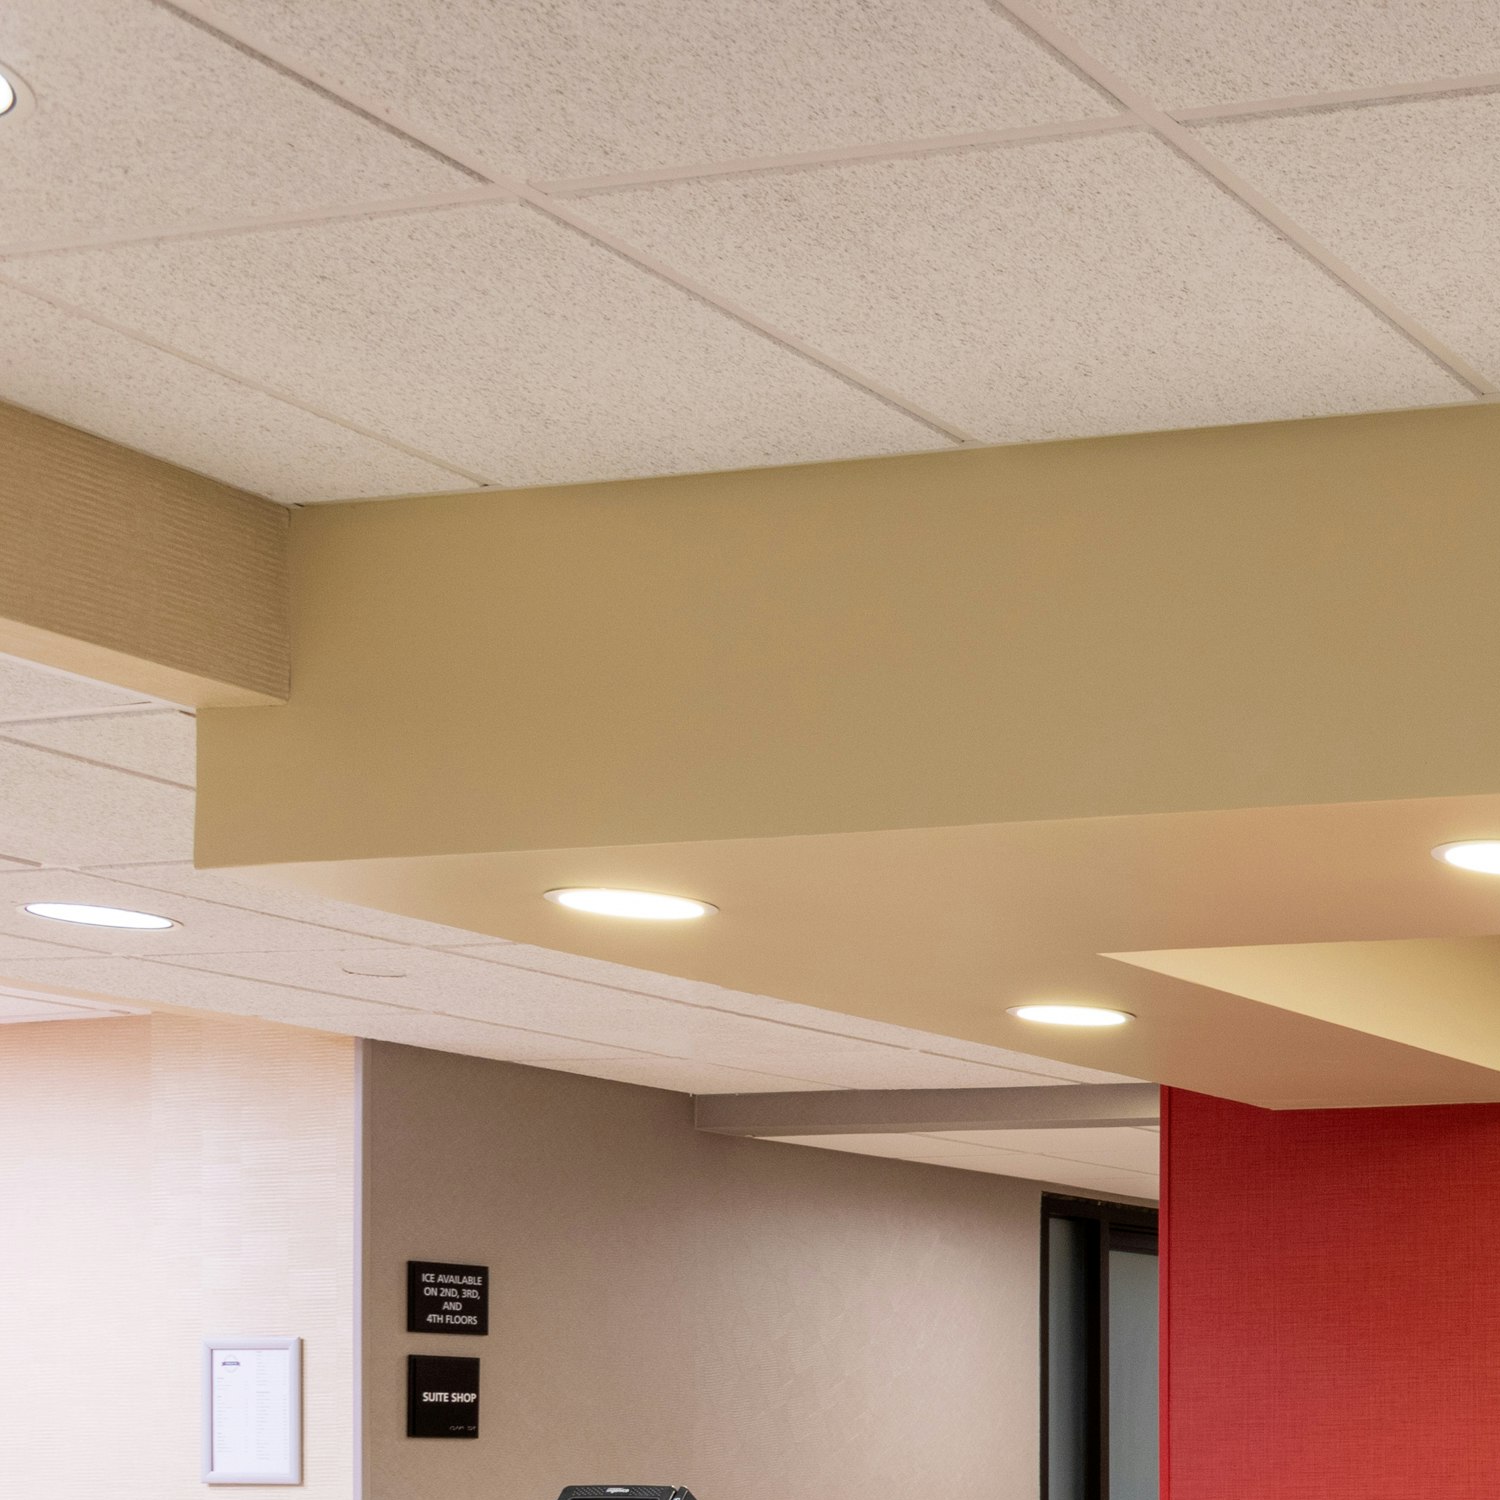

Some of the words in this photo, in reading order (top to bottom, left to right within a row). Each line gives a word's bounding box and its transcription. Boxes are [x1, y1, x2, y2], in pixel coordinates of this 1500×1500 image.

[422, 1273, 435, 1283] ICE
[437, 1274, 483, 1286] AVAILABLE
[424, 1287, 438, 1297] ON
[440, 1287, 460, 1299] 2ND,
[462, 1289, 481, 1300] 3RD,
[443, 1302, 463, 1311] AND
[426, 1314, 444, 1324] 4TH
[446, 1315, 478, 1325] FLOORS
[422, 1392, 449, 1402] SUITE
[451, 1392, 477, 1403] SHOP
